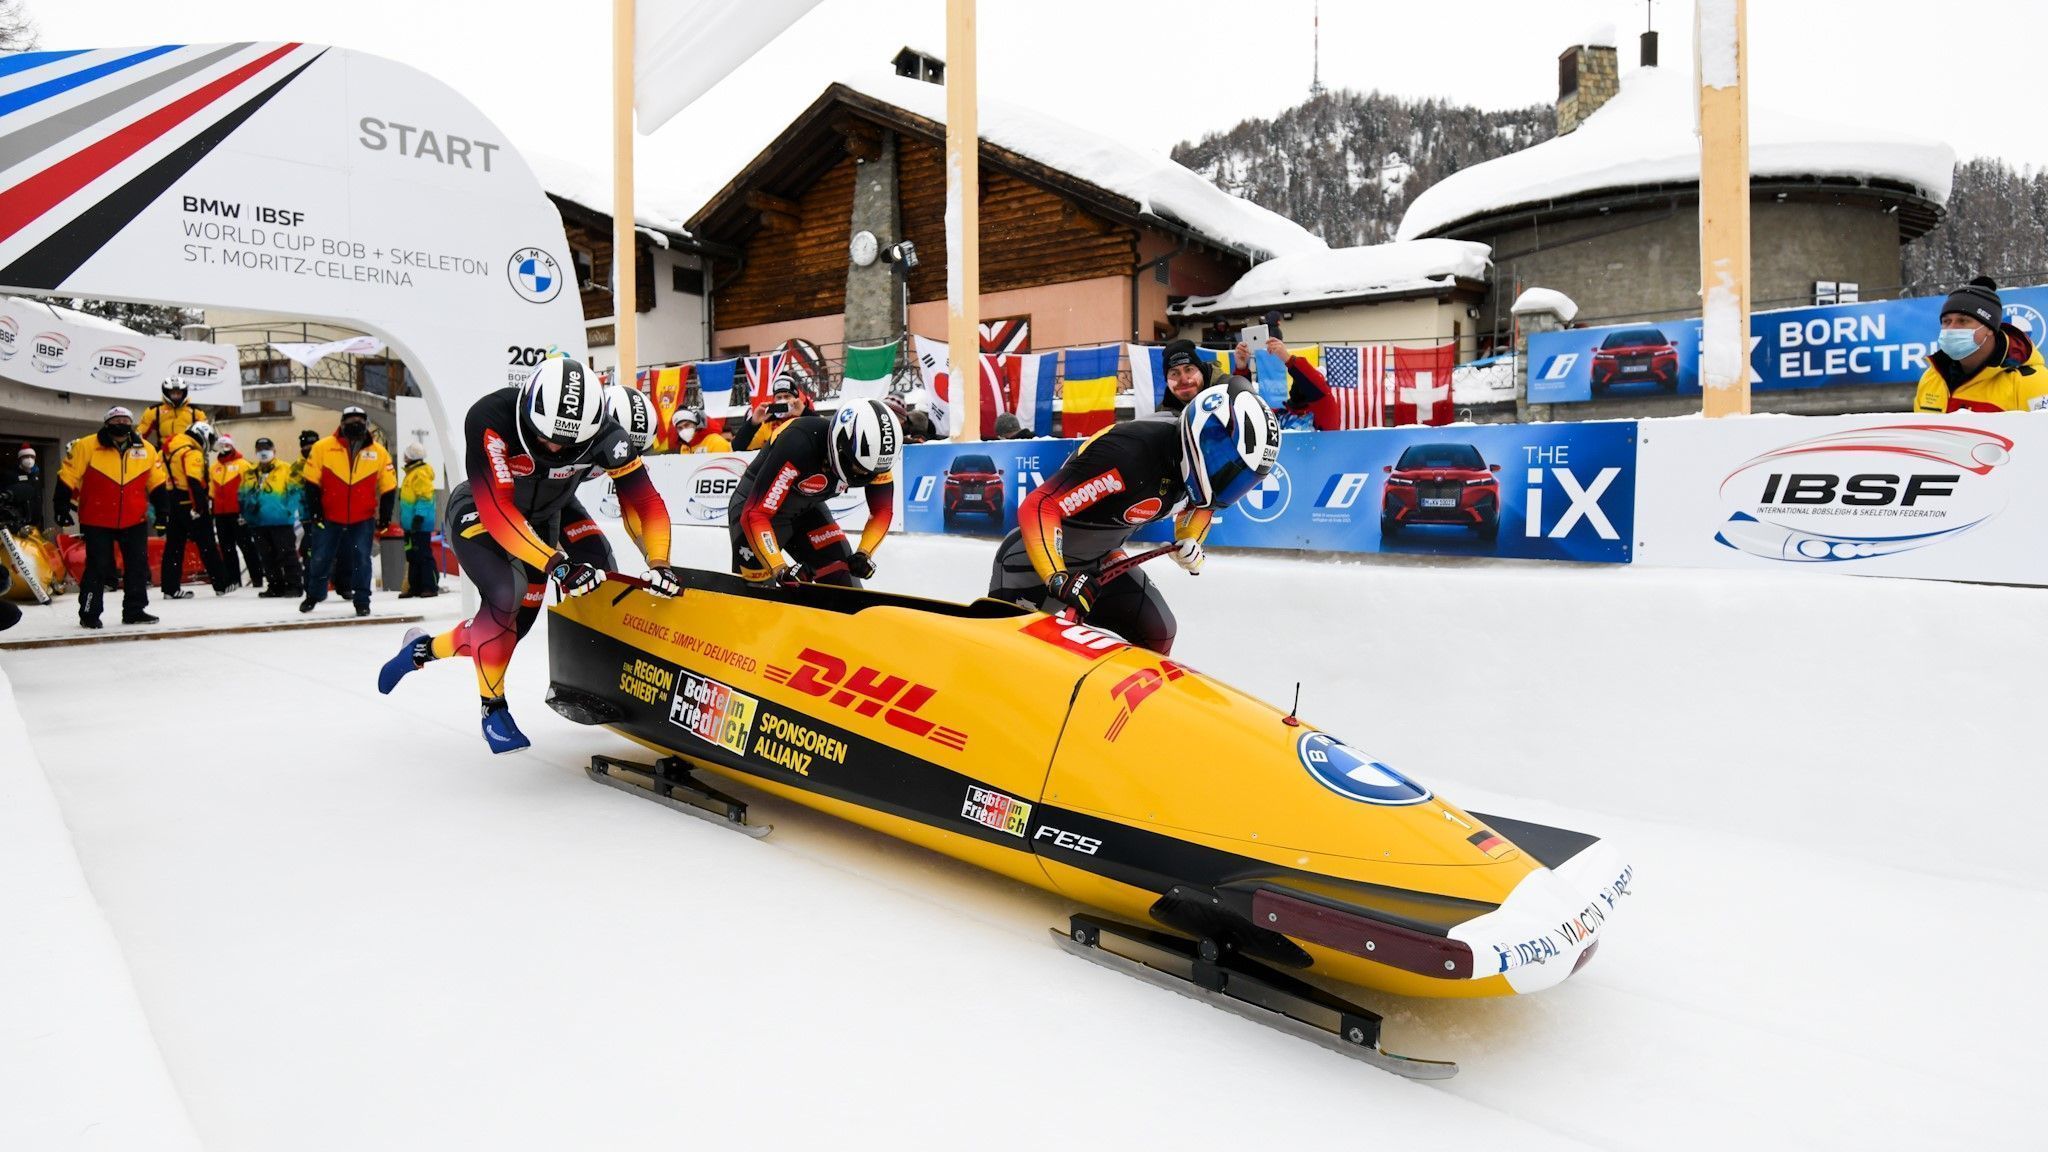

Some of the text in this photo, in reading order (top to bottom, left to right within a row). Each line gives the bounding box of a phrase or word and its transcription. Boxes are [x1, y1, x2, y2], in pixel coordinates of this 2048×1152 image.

[359, 116, 499, 173] START
[182, 195, 305, 227] BMW IBSF
[182, 219, 266, 246] WORLD
[273, 232, 315, 251] CUP
[322, 238, 366, 259] BOB
[391, 248, 489, 276] SKELETON
[515, 250, 554, 267] BMW
[184, 244, 413, 287] ST. MORITZ-CELERINA
[1977, 308, 1992, 320] SEIZ
[0, 329, 15, 344] BSF
[1780, 314, 1885, 348] BORN
[36, 342, 64, 357] IBSF
[100, 356, 137, 369] IBSF
[1780, 341, 1938, 378] ELECTRI
[178, 365, 218, 377] IBSF
[563, 371, 581, 416] xDrive
[555, 420, 580, 431] BMW
[633, 394, 645, 430] xDrive
[882, 413, 893, 453] xDrive
[1016, 456, 1040, 470] THE
[1523, 445, 1569, 464] THE
[695, 479, 738, 494] IBSF
[1760, 473, 1961, 506] IBSF
[1525, 467, 1622, 540] iX
[1757, 507, 1811, 515] INTERNATIONAL
[1812, 508, 1851, 516] BOBSLEIGH
[1860, 509, 1897, 517] SKELETON
[1899, 510, 1947, 518] FEDERATION
[575, 570, 592, 586] SEIZ
[1072, 573, 1089, 596] SEIZ
[622, 613, 757, 674] EXCELLENCE. SIMPLY DELIVERED.
[619, 673, 668, 706] SCHIEBT AN
[623, 659, 674, 691] EINE REGION
[785, 648, 938, 737] DHL
[671, 694, 749, 751] Friedrich
[759, 712, 848, 764] SPONSOREN
[754, 736, 812, 777] ALLIANZ
[962, 800, 1025, 834] Friedrich
[1442, 809, 1473, 830] 1
[1034, 825, 1103, 855] FES
[1514, 936, 1560, 966] IDEAL
